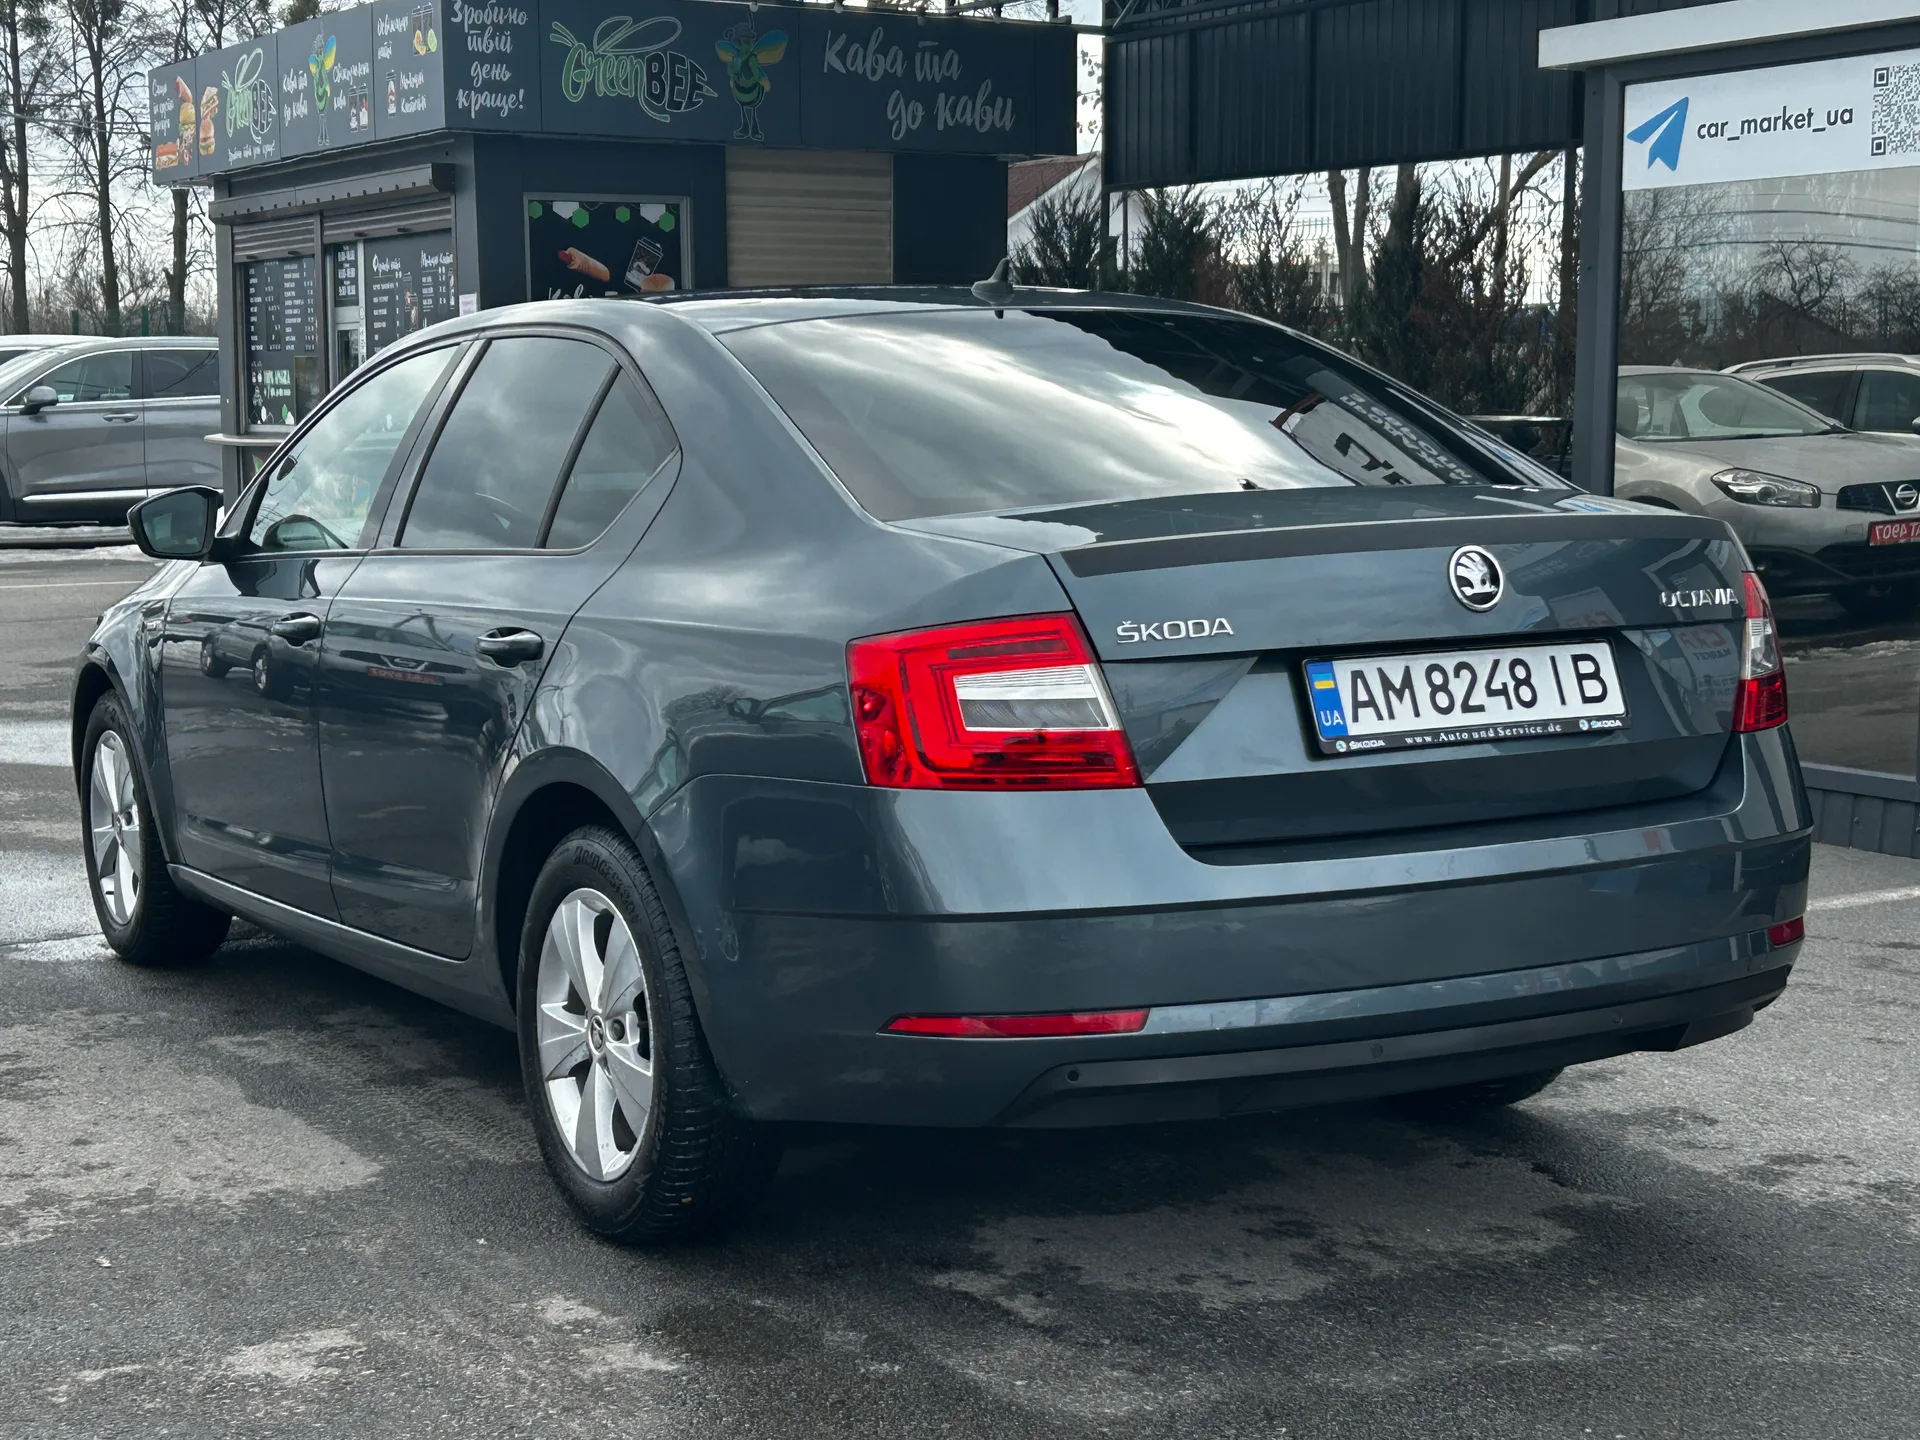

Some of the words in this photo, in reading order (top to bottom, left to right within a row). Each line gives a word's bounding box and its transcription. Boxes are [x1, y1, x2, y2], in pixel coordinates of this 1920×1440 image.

[451, 0, 528, 33] Зробимо
[467, 26, 513, 54] твій
[823, 26, 907, 82] Кава
[915, 41, 963, 83] та
[470, 61, 512, 88] день
[456, 88, 525, 119] краще!
[887, 89, 925, 141] до
[933, 79, 1016, 133] кави
[1697, 105, 1854, 142] car_market_ua
[1116, 617, 1234, 644] ŠKODA
[1320, 710, 1344, 727] UA
